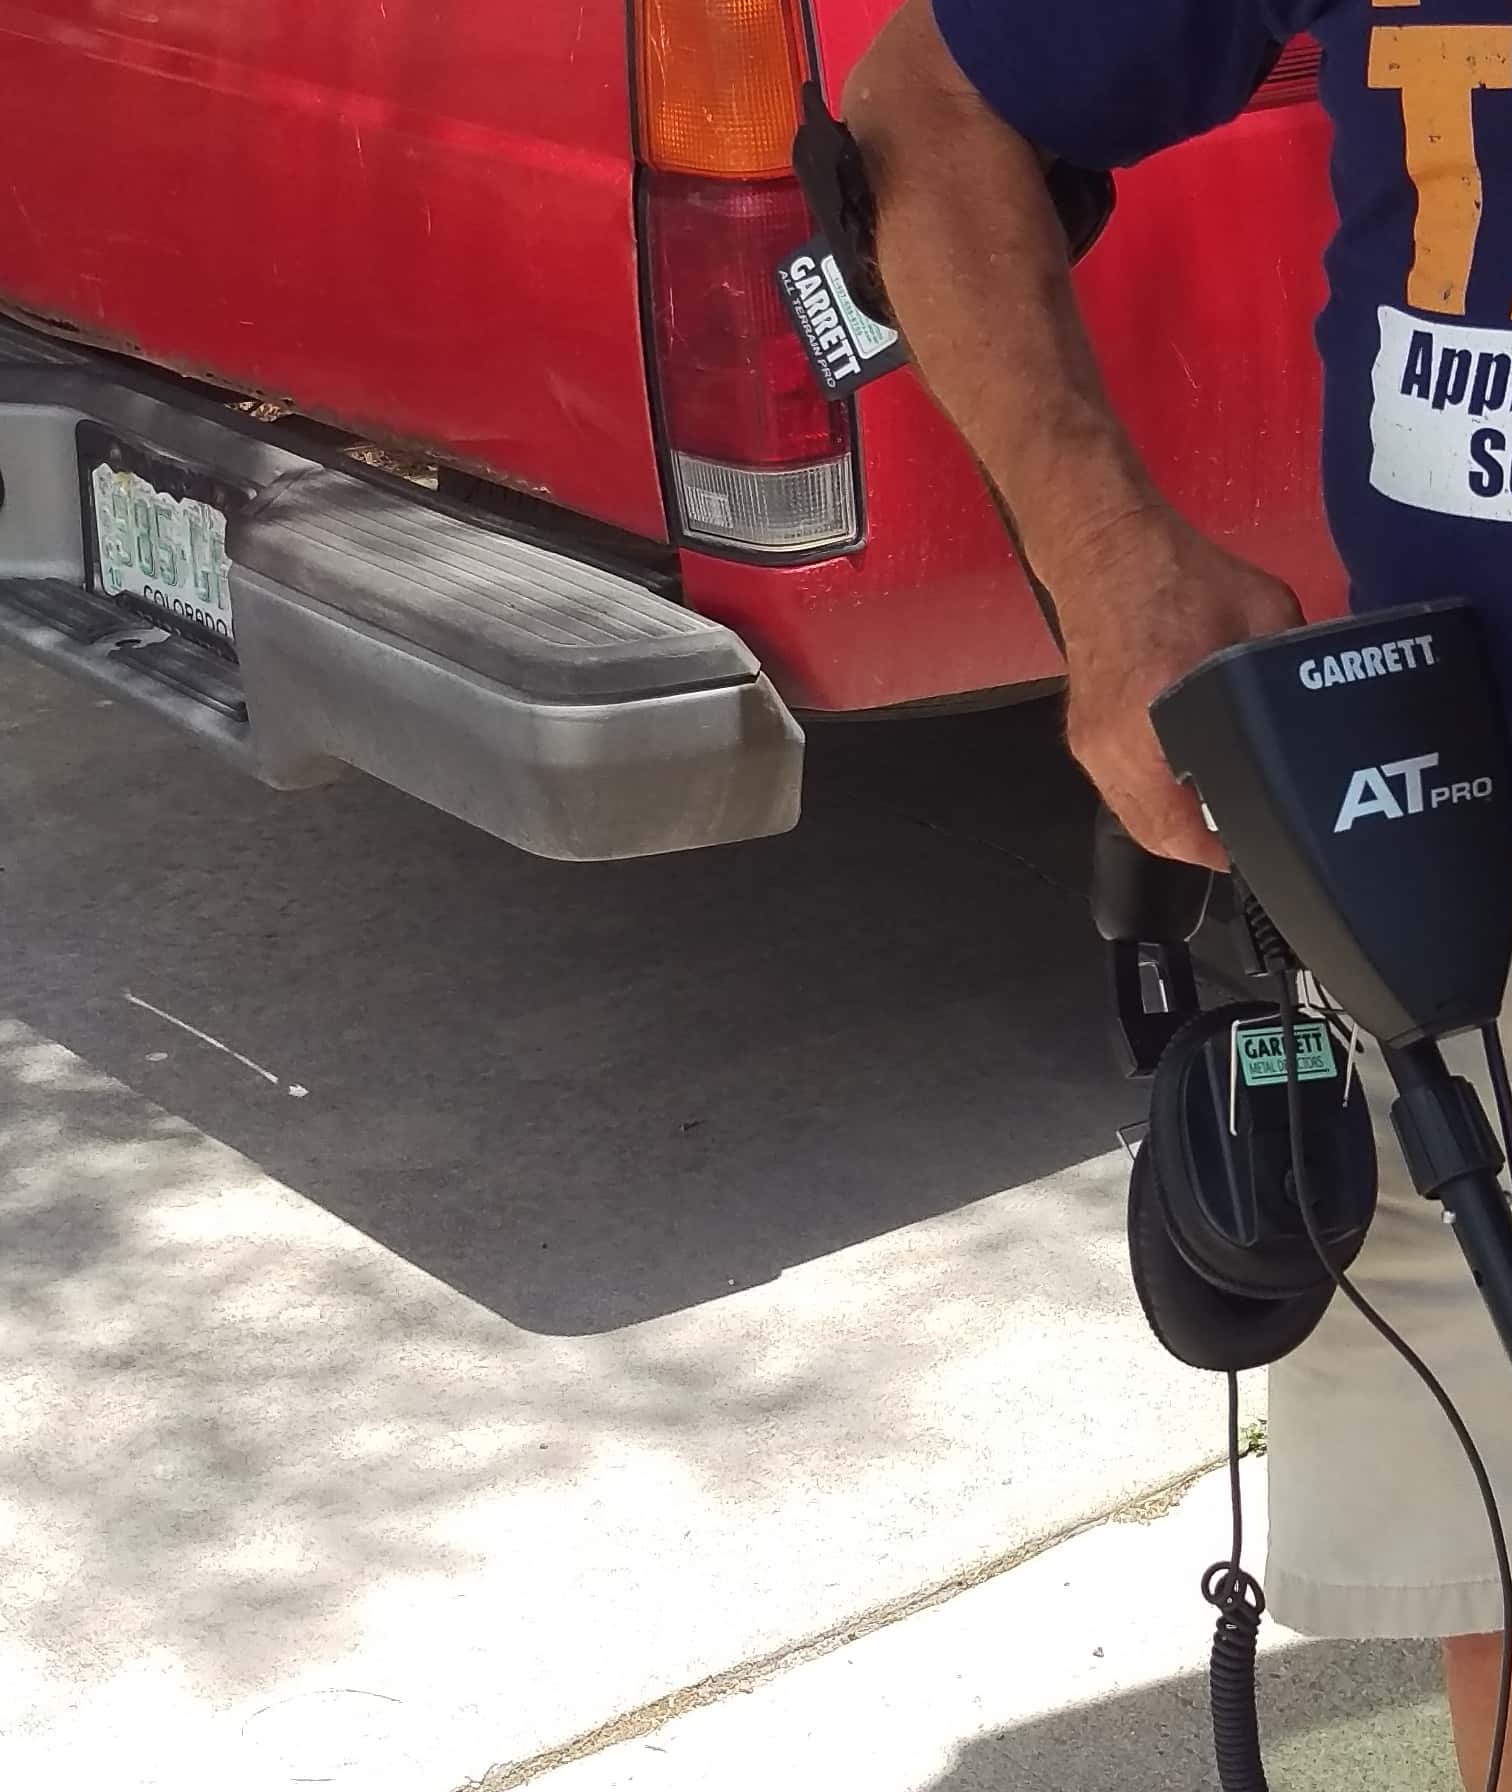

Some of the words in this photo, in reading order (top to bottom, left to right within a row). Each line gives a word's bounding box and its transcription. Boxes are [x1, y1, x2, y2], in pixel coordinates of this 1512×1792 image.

[777, 269, 794, 296] ALL
[791, 297, 824, 357] TERRAIN
[816, 358, 837, 389] PRO
[789, 256, 862, 381] GARRETT
[1299, 634, 1435, 690] GARRETT
[1333, 751, 1440, 834] AT
[1431, 776, 1493, 809] PRO
[1244, 1033, 1322, 1059] GARETT
